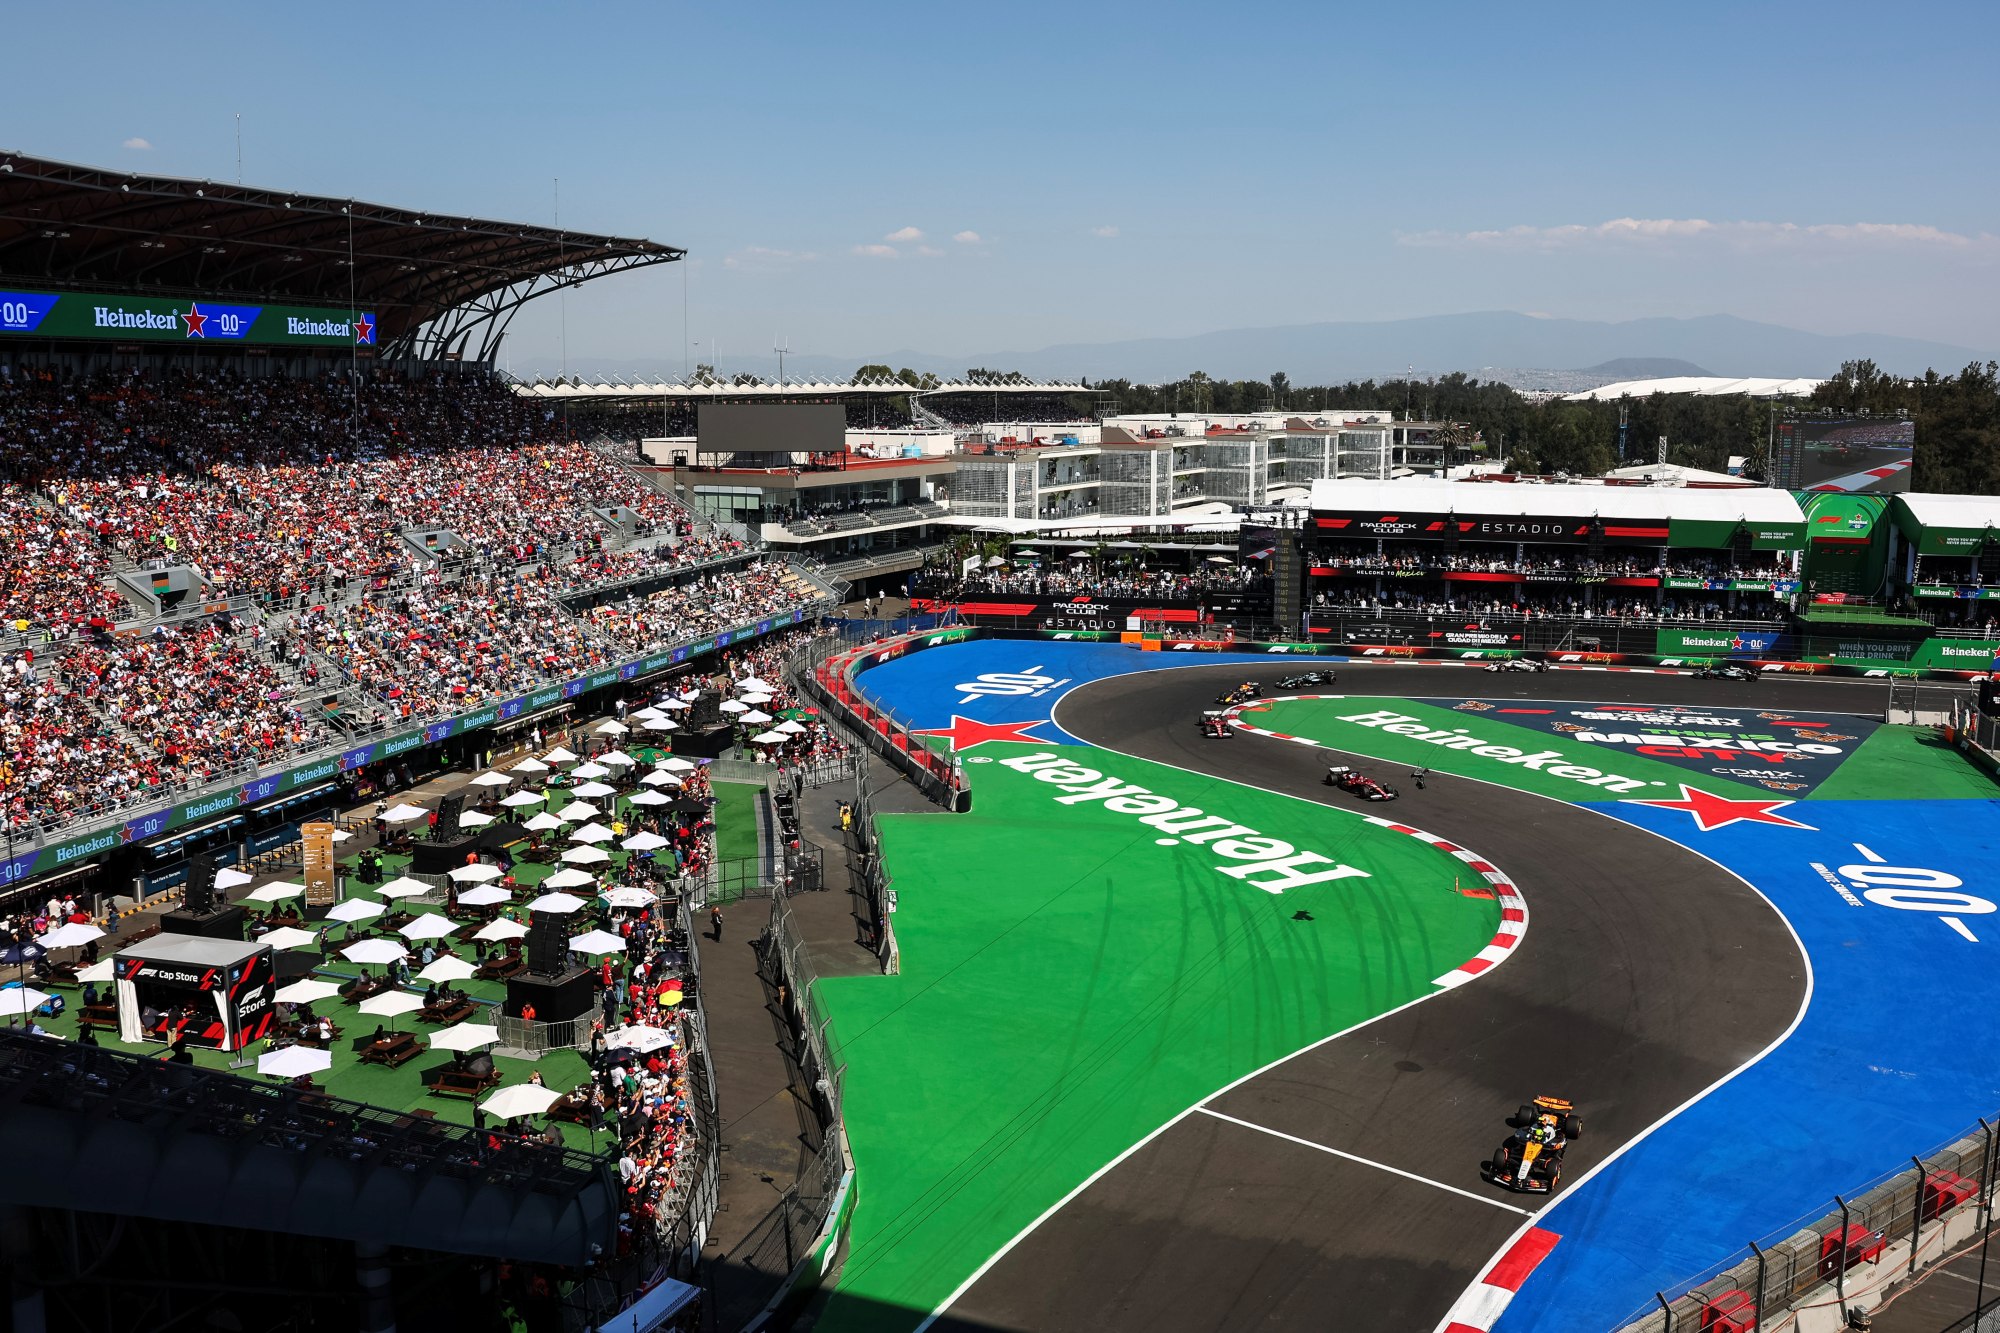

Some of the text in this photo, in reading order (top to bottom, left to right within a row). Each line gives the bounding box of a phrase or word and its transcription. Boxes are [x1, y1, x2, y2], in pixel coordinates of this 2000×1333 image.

[3, 302, 27, 324] 0.0
[94, 306, 239, 332] Heineken 0.0
[287, 317, 350, 336] Heineken
[1482, 523, 1562, 534] ESTADIO
[1046, 618, 1115, 628] ESTADIO
[1682, 637, 1727, 646] Heineken
[1942, 647, 1988, 656] Heineken
[1640, 728, 1732, 739] THIS
[1335, 710, 1641, 792] Heineken
[1575, 732, 1843, 755] MEXICO
[1636, 745, 1787, 763] CITY
[56, 837, 113, 862] Heineken
[186, 796, 233, 819] Heineken
[293, 763, 333, 784] Heineken
[385, 736, 419, 754] Heineken
[464, 712, 493, 729] Heineken
[533, 691, 558, 706] Heineken
[593, 674, 616, 686] Heineken
[1712, 768, 1797, 777] CDMX
[999, 752, 1372, 894] Heineken
[1838, 865, 1997, 914] 0.0
[159, 970, 174, 980] Cap
[176, 972, 198, 982] Store
[240, 998, 266, 1017] Store
